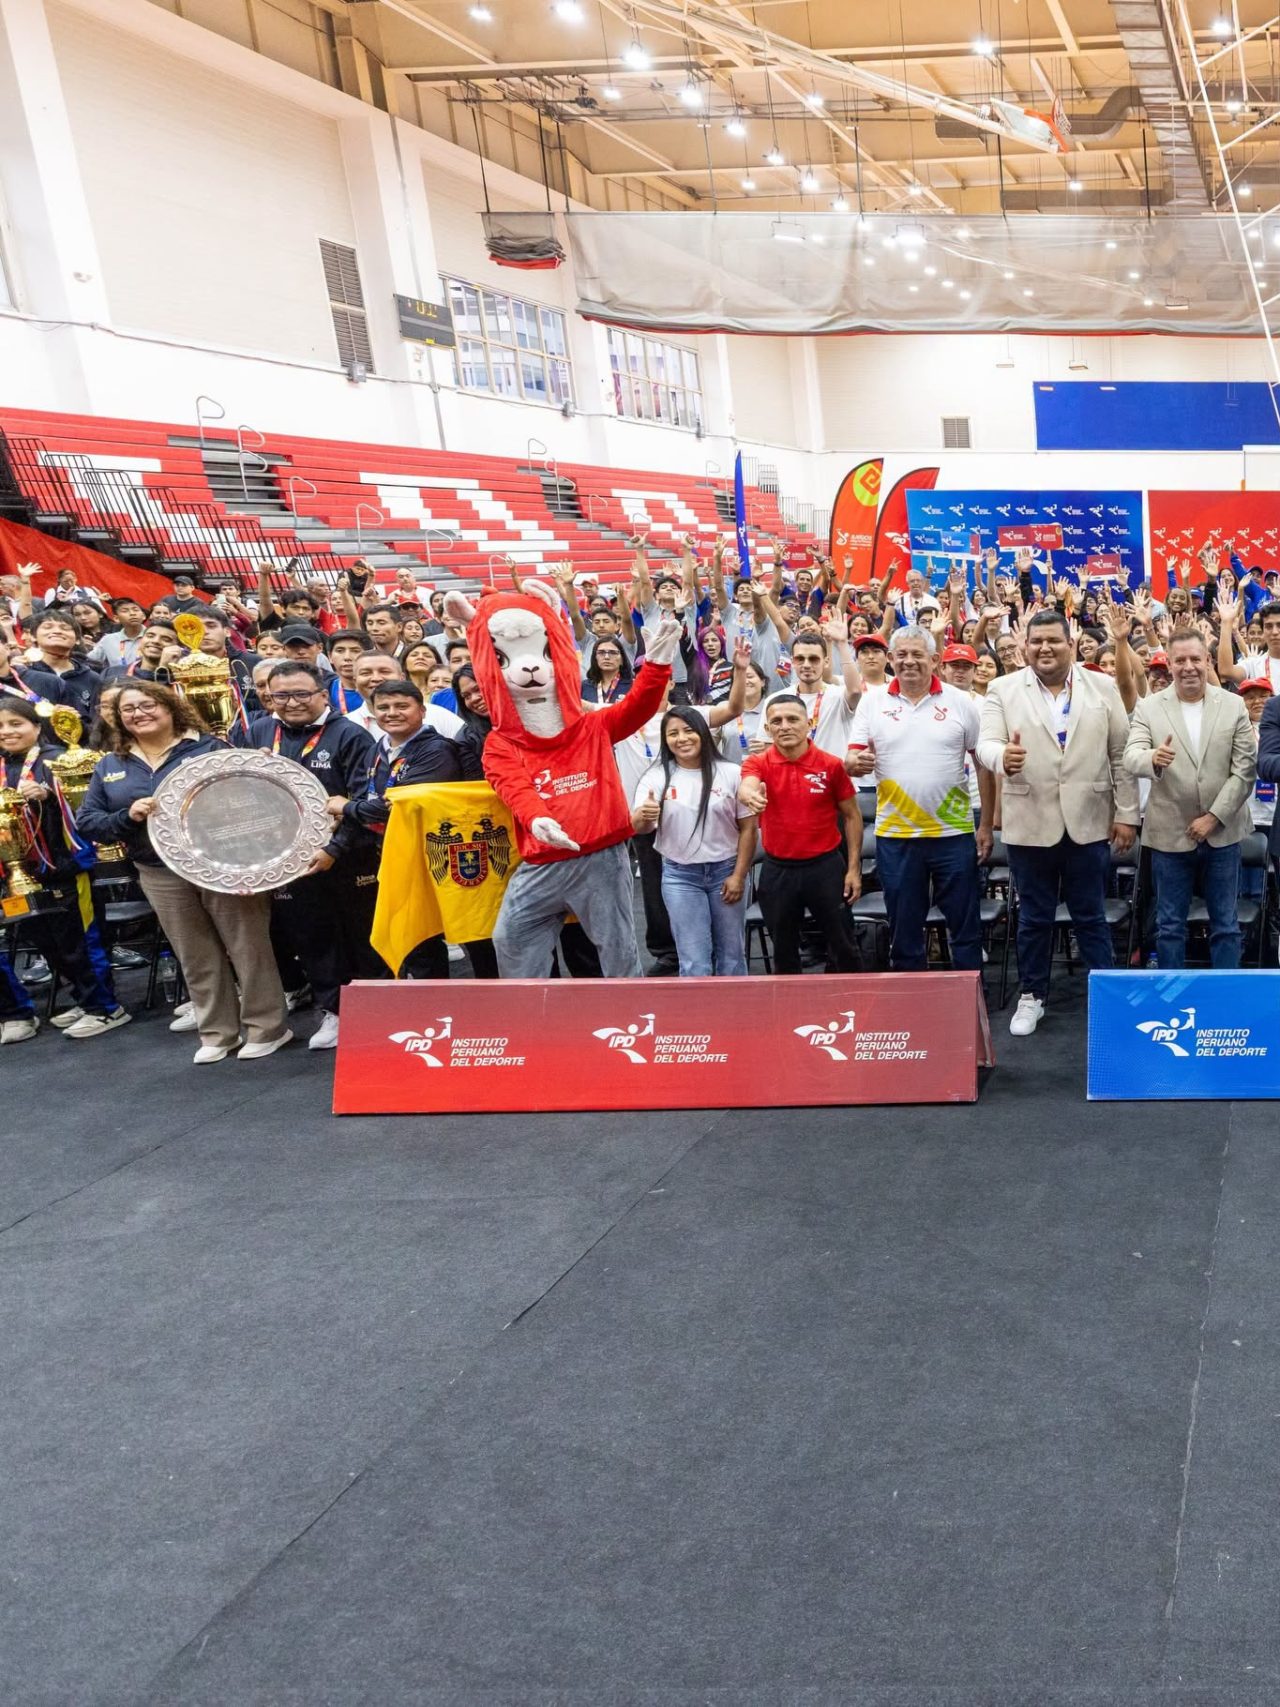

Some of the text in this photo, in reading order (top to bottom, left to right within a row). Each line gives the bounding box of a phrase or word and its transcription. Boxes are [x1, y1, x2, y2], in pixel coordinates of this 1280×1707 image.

[311, 761, 331, 769] LIMA
[552, 771, 588, 785] INSTITUTO
[554, 777, 587, 791] PERUANO
[555, 787, 569, 796] DEL
[855, 1032, 910, 1041] INSTITUTO
[1152, 1029, 1177, 1041] IPD
[1196, 1029, 1249, 1037] INSTITUTO
[451, 1038, 508, 1047] INSTITUTO
[609, 1036, 635, 1048] IPD
[654, 1035, 710, 1044] INSTITUTO
[810, 1033, 836, 1045] IPD
[405, 1039, 432, 1052] IPD
[654, 1045, 706, 1053] PERUANO
[855, 1041, 906, 1050] PERUANO
[451, 1048, 504, 1056] PERUANO
[854, 1051, 927, 1060] DEL DEPORTE
[1196, 1048, 1267, 1056] DEL DEPORTE
[450, 1057, 525, 1067] DEL DEPORTE
[654, 1054, 728, 1063] DEL DEPORTE
